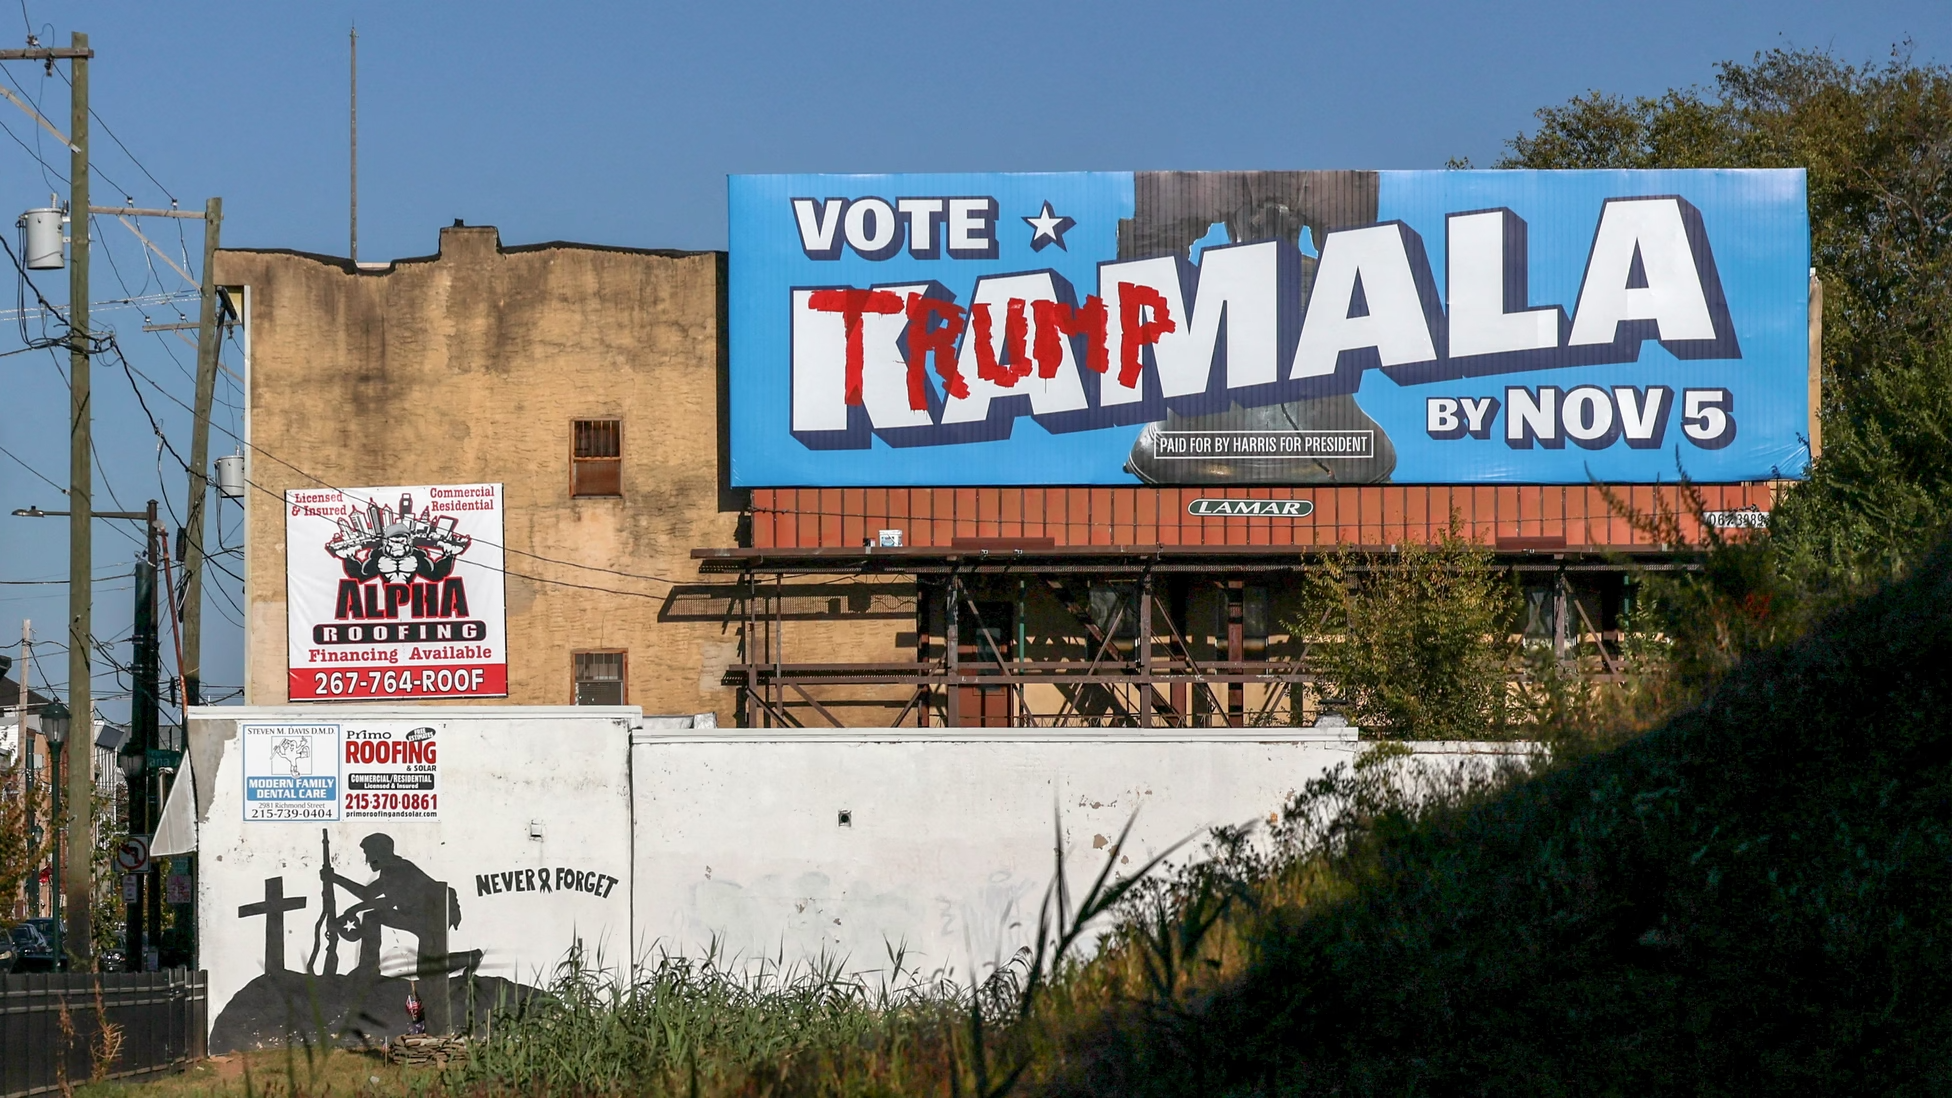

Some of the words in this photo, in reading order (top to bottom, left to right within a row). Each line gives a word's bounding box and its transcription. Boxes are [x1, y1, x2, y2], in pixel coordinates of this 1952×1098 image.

[790, 196, 999, 260] VOTE
[789, 194, 1742, 450] KAMALA
[808, 281, 1176, 412] TRUMP
[1426, 396, 1500, 440] BY
[1505, 385, 1675, 449] NOV
[1681, 387, 1736, 449] 5
[1160, 437, 1187, 453] PAID
[1190, 437, 1211, 453] FOR
[1215, 437, 1230, 453] BY
[1233, 437, 1277, 453] HARRIS
[1280, 437, 1302, 452] FOR
[1305, 436, 1368, 452] PRESIDENT
[294, 492, 343, 504] Licensed
[430, 486, 495, 499] Commercial
[291, 505, 301, 516] &
[303, 505, 347, 516] Insured
[431, 499, 494, 511] Residential
[1198, 501, 1301, 515] LAMAR
[335, 576, 470, 620] ALPHA
[322, 624, 478, 642] ROOFING
[308, 648, 399, 663] Financing
[409, 645, 492, 660] Available
[314, 669, 485, 695] 267-764-ROOF
[247, 727, 275, 735] STEVEN
[276, 727, 287, 735] M.
[288, 727, 310, 735] DAVIS
[311, 727, 336, 735] D.M.D.
[346, 730, 392, 740] Primo
[345, 741, 437, 765] ROOFING
[248, 778, 294, 788] MODERN
[296, 778, 335, 788] FAMILY
[350, 774, 433, 783] COMMERCIAL/RESIDENTIAL
[256, 789, 297, 799] DENTAL
[298, 789, 327, 799] CARE
[251, 809, 333, 819] 215-739-0404
[475, 868, 536, 897] NEVER
[555, 867, 619, 899] FORGET
